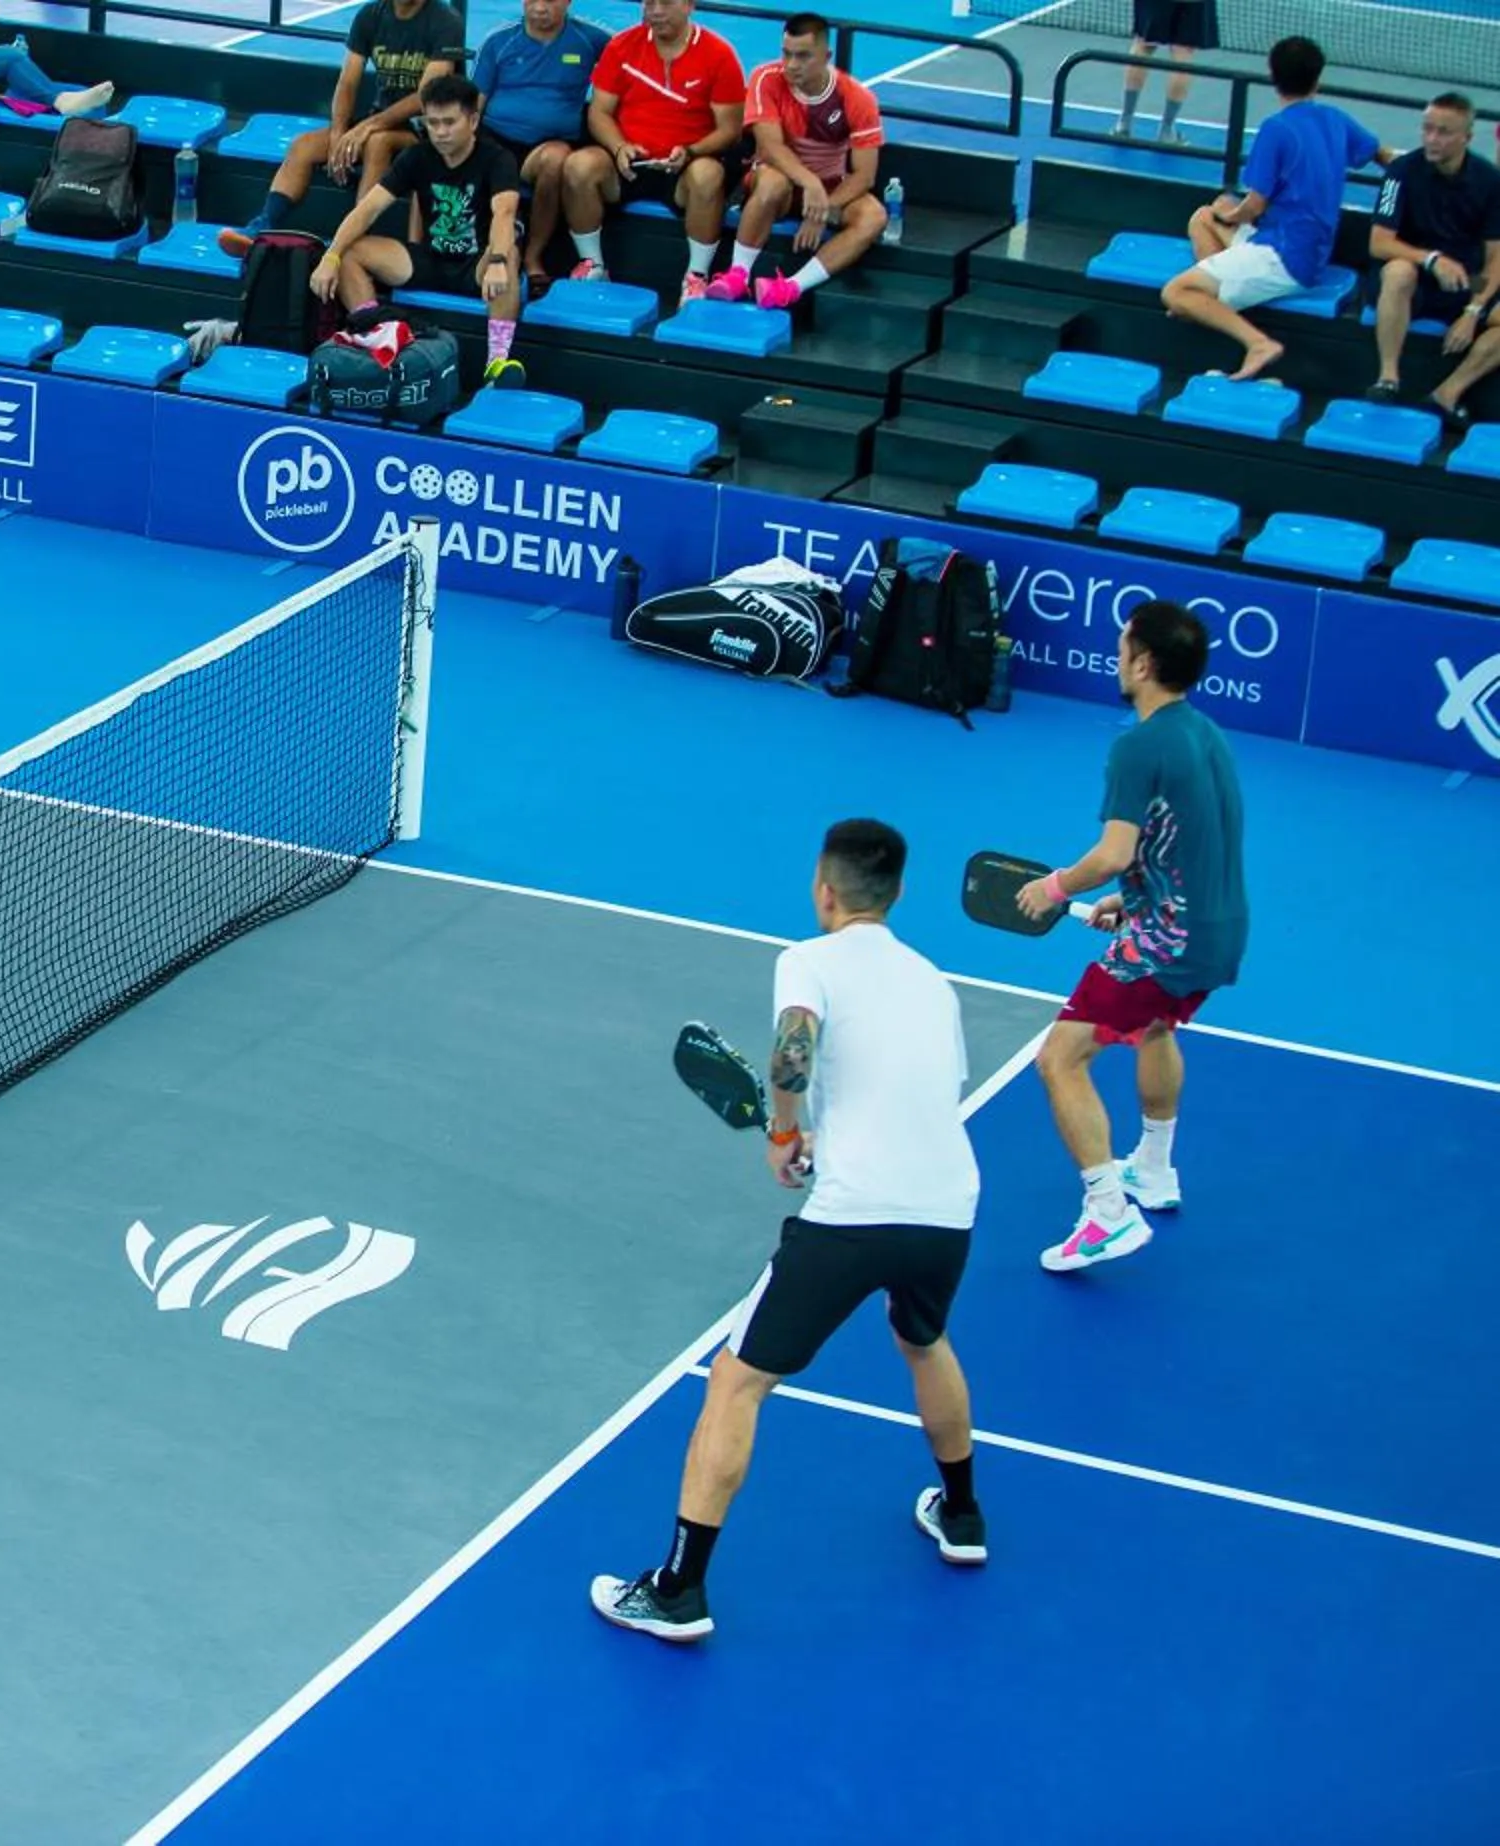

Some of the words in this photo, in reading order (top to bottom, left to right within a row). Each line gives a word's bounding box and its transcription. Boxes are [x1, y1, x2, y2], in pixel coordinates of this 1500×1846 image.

[267, 445, 332, 505] pb
[375, 456, 621, 532] COOLLIEN
[265, 500, 329, 521] pickleball
[372, 511, 619, 583] AADEMY
[763, 521, 881, 586] TEA
[1011, 640, 1058, 666] ALL
[1067, 648, 1262, 703] DESIONS
